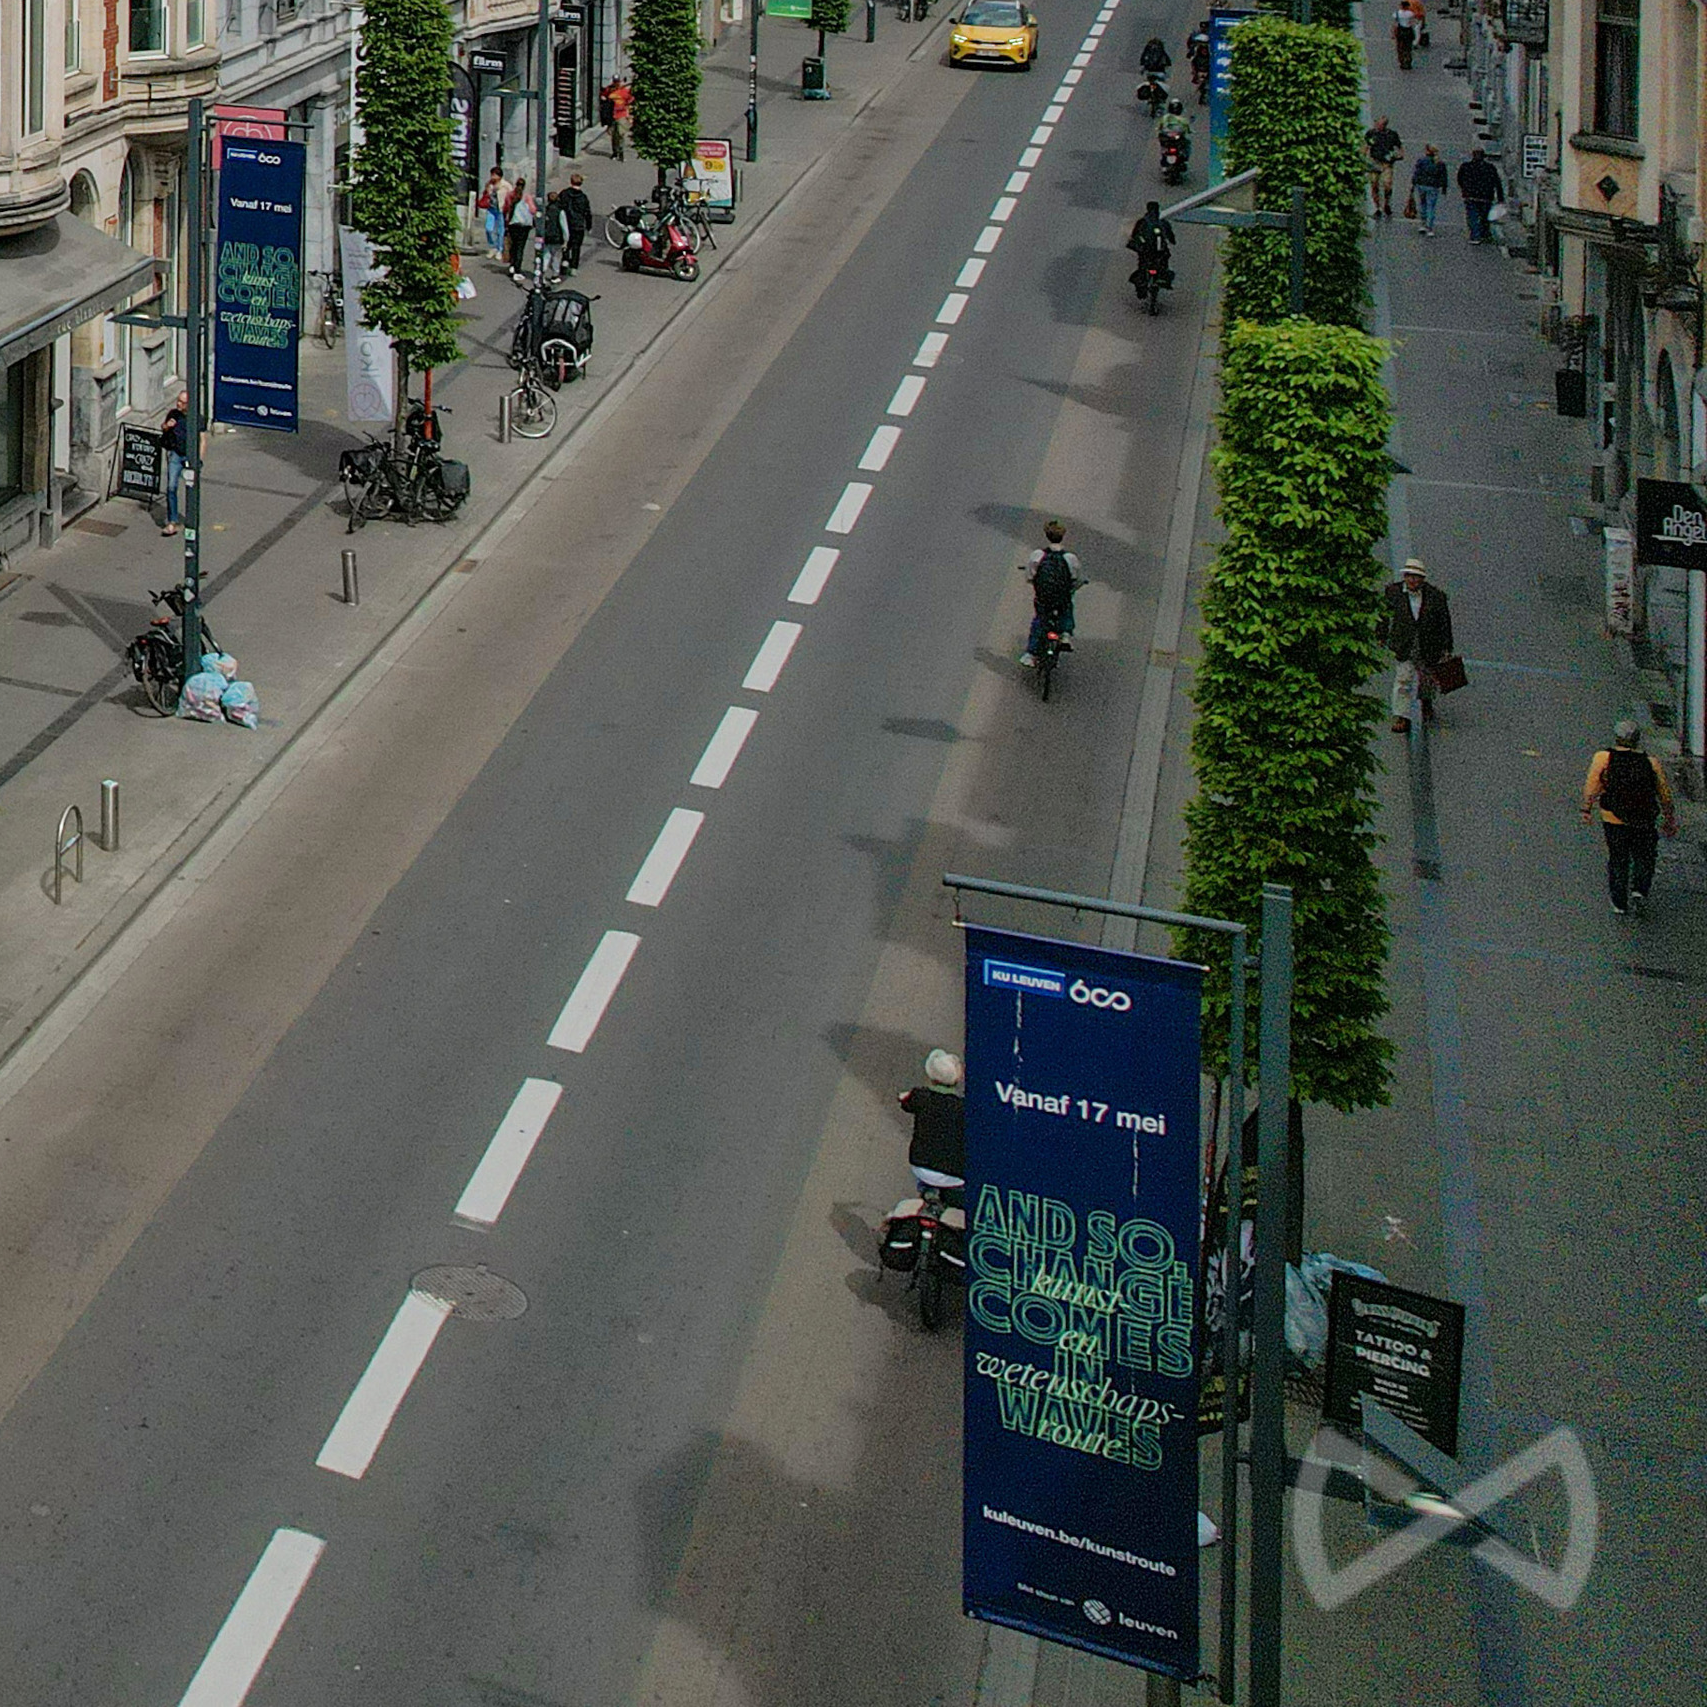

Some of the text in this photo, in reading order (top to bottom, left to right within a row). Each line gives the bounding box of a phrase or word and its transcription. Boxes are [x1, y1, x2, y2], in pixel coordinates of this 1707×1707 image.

[230, 197, 292, 213] Vanaf 17 mei
[220, 241, 259, 263] AND
[1663, 516, 1707, 546] Angel
[1673, 504, 1702, 525] Den
[992, 969, 1010, 983] KU
[1012, 973, 1062, 992] LEUVEN
[995, 1081, 1166, 1135] Vanaf 17 mei
[974, 1184, 1076, 1251] AND
[969, 1232, 1193, 1329] CHANGE
[1031, 1264, 1131, 1314] kunst-
[969, 1279, 1193, 1378] COMES
[1059, 1330, 1098, 1355] en
[1355, 1329, 1417, 1357] TATTOO
[1354, 1346, 1431, 1378] PIERCING
[976, 1351, 1185, 1424] wetenschaps-
[997, 1379, 1163, 1471] WAVES
[1039, 1419, 1123, 1458] route
[983, 1505, 1176, 1577] kuleuven.be/kunstroute
[1119, 1612, 1178, 1640] leuven
